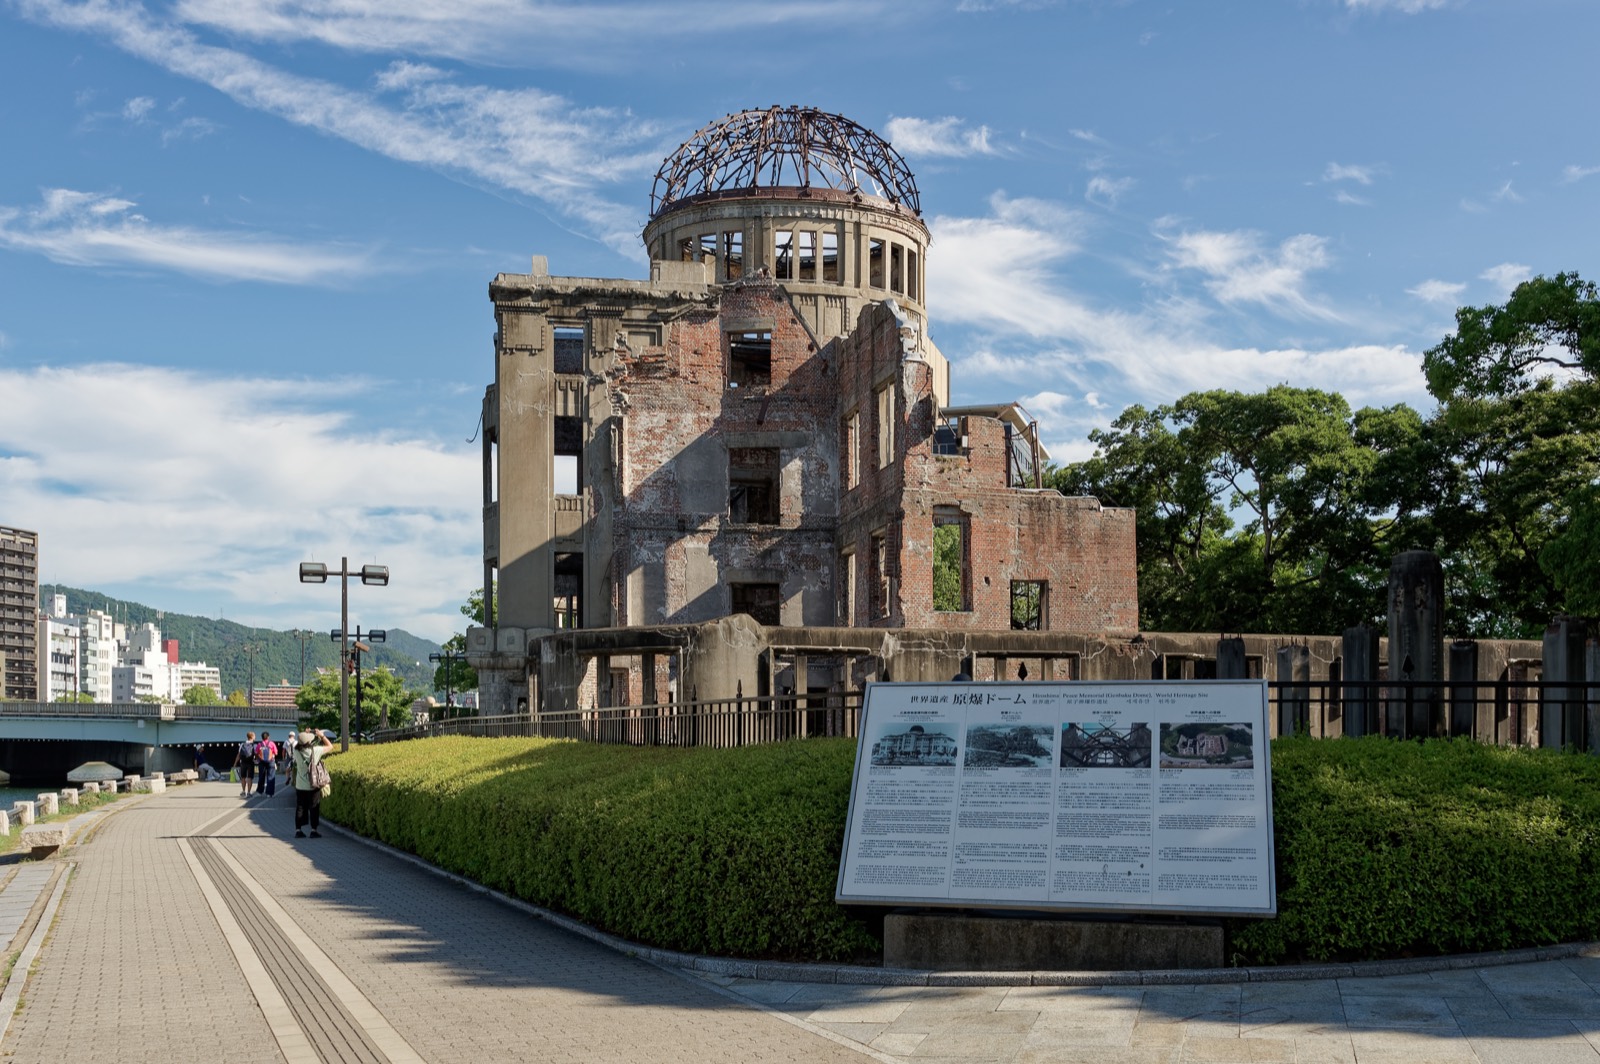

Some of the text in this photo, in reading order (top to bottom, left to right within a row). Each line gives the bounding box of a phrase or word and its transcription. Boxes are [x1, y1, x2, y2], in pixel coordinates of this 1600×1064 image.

[911, 693, 1027, 705] 世界遺産 原爆ドーム
